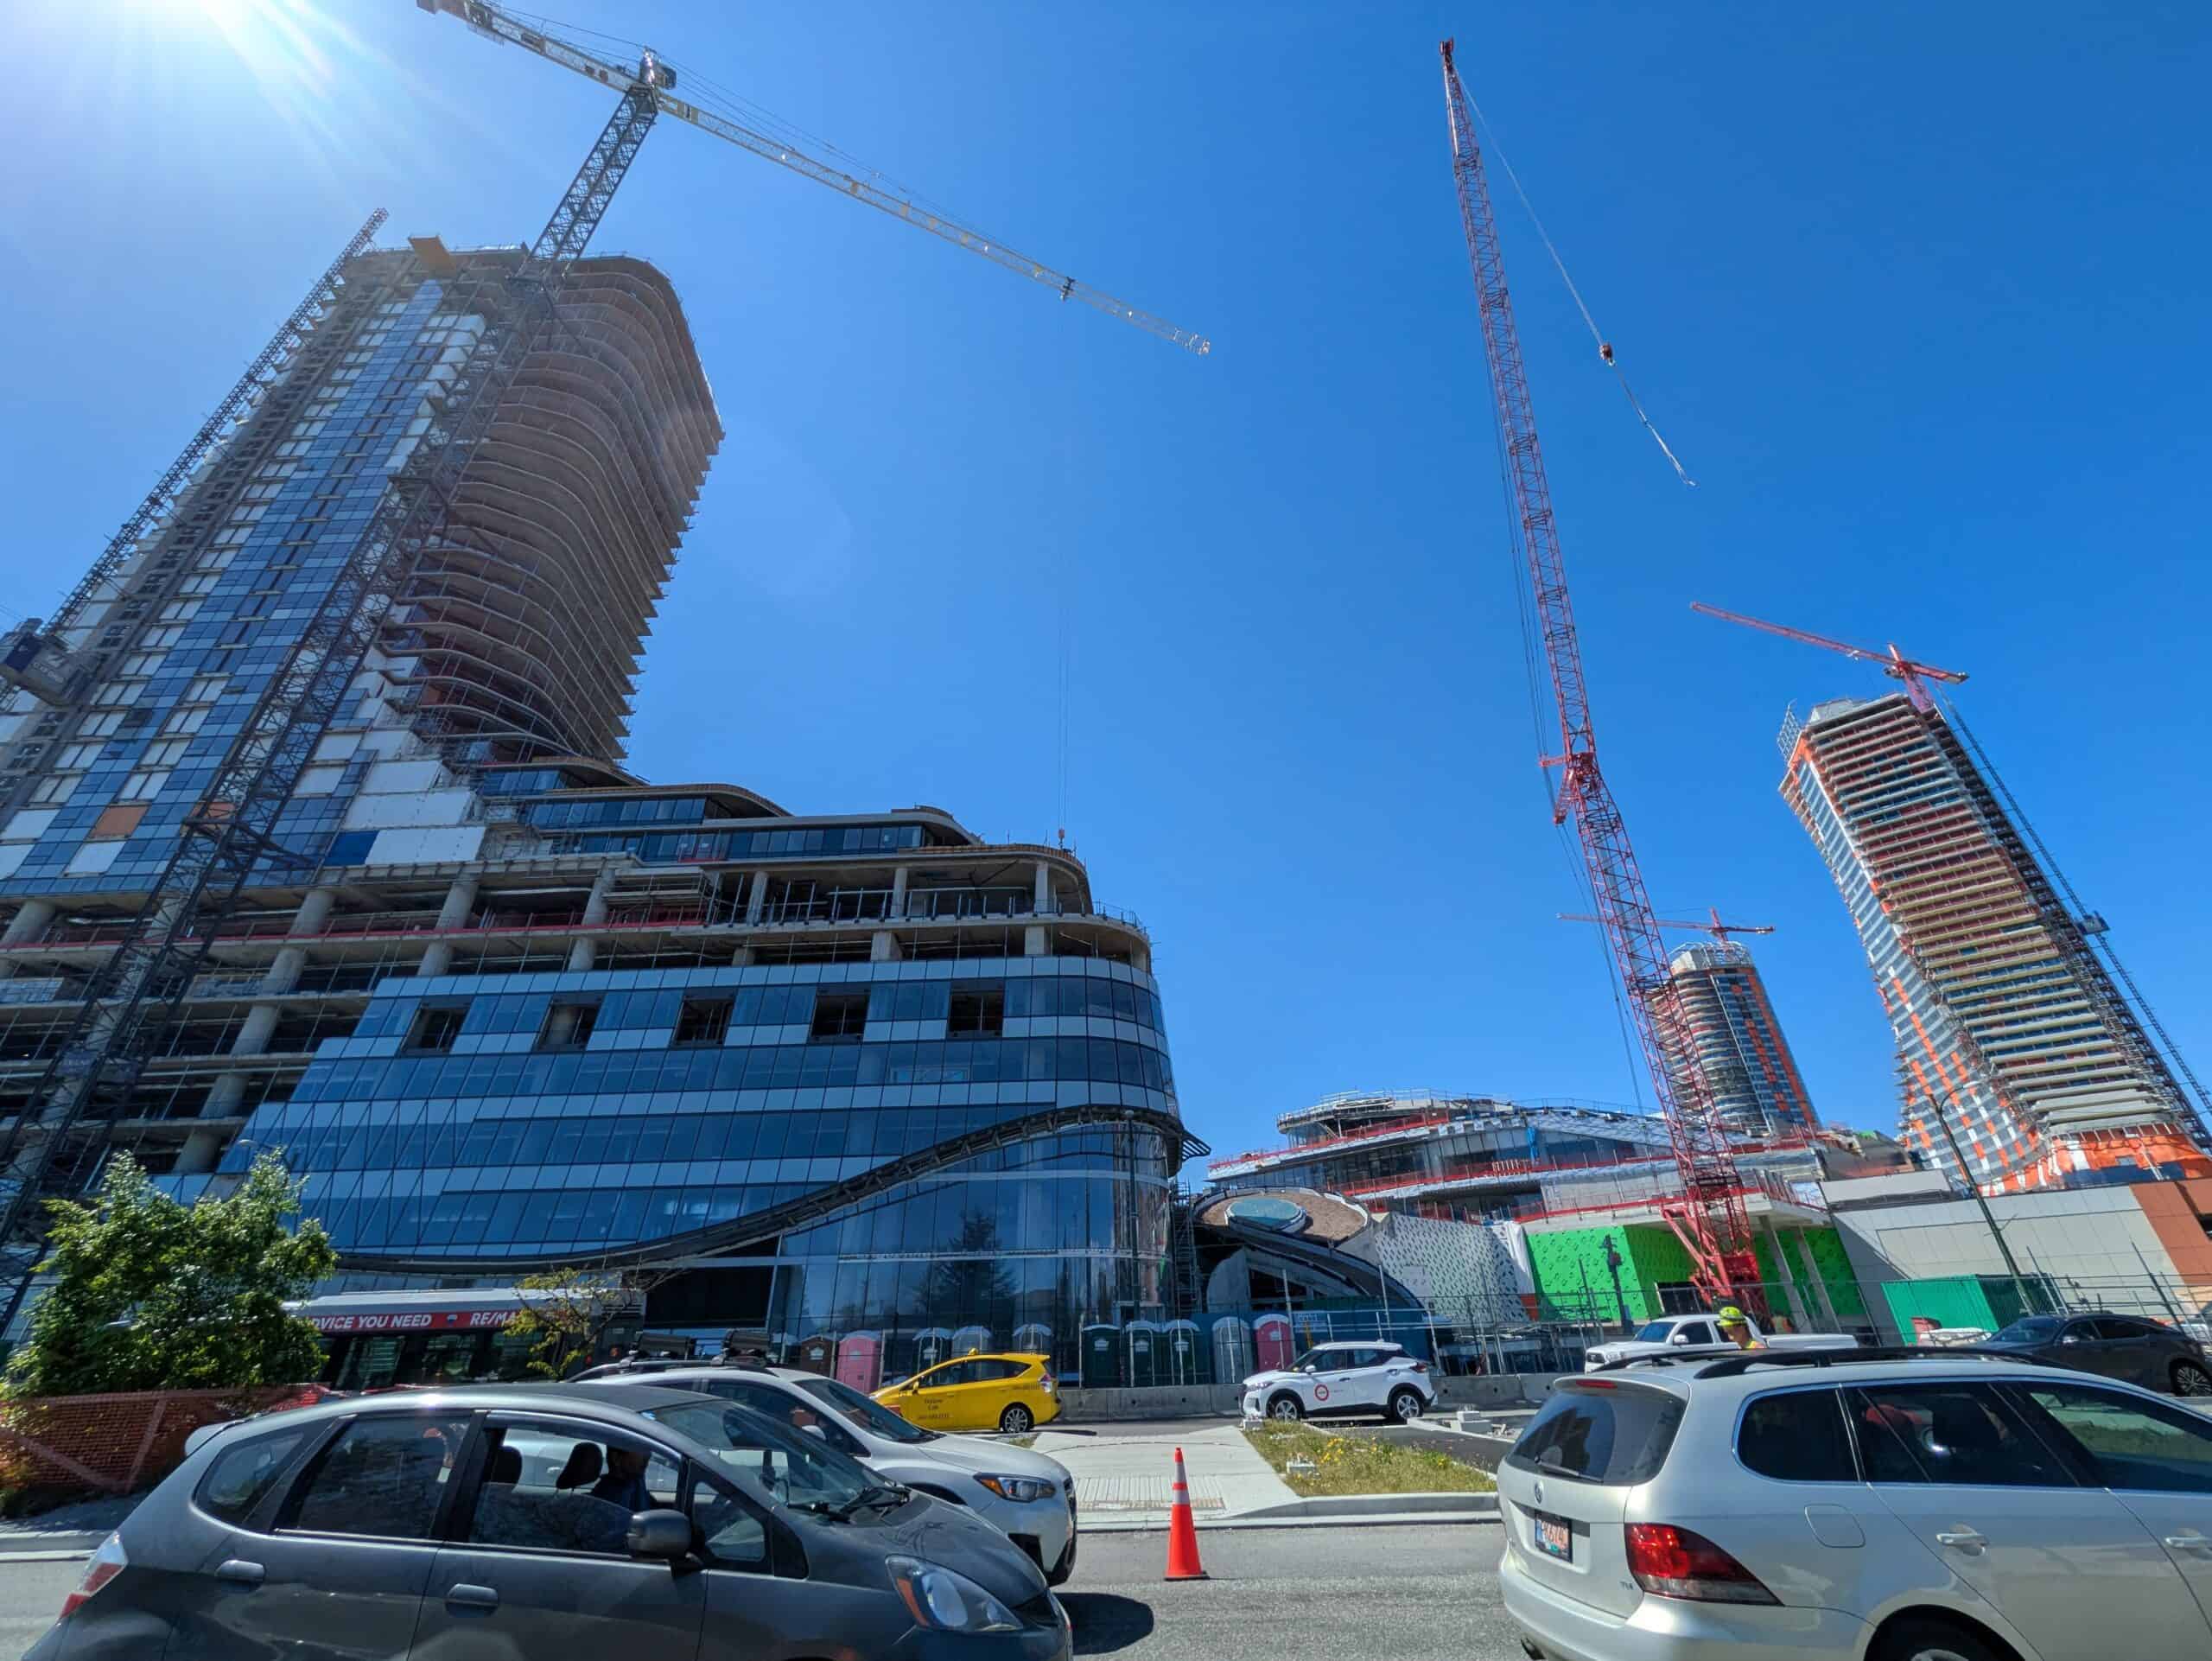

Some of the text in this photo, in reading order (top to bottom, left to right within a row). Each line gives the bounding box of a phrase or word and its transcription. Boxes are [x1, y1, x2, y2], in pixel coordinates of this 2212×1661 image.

[311, 1311, 518, 1329] DVICE YOU NEED RE/MA
